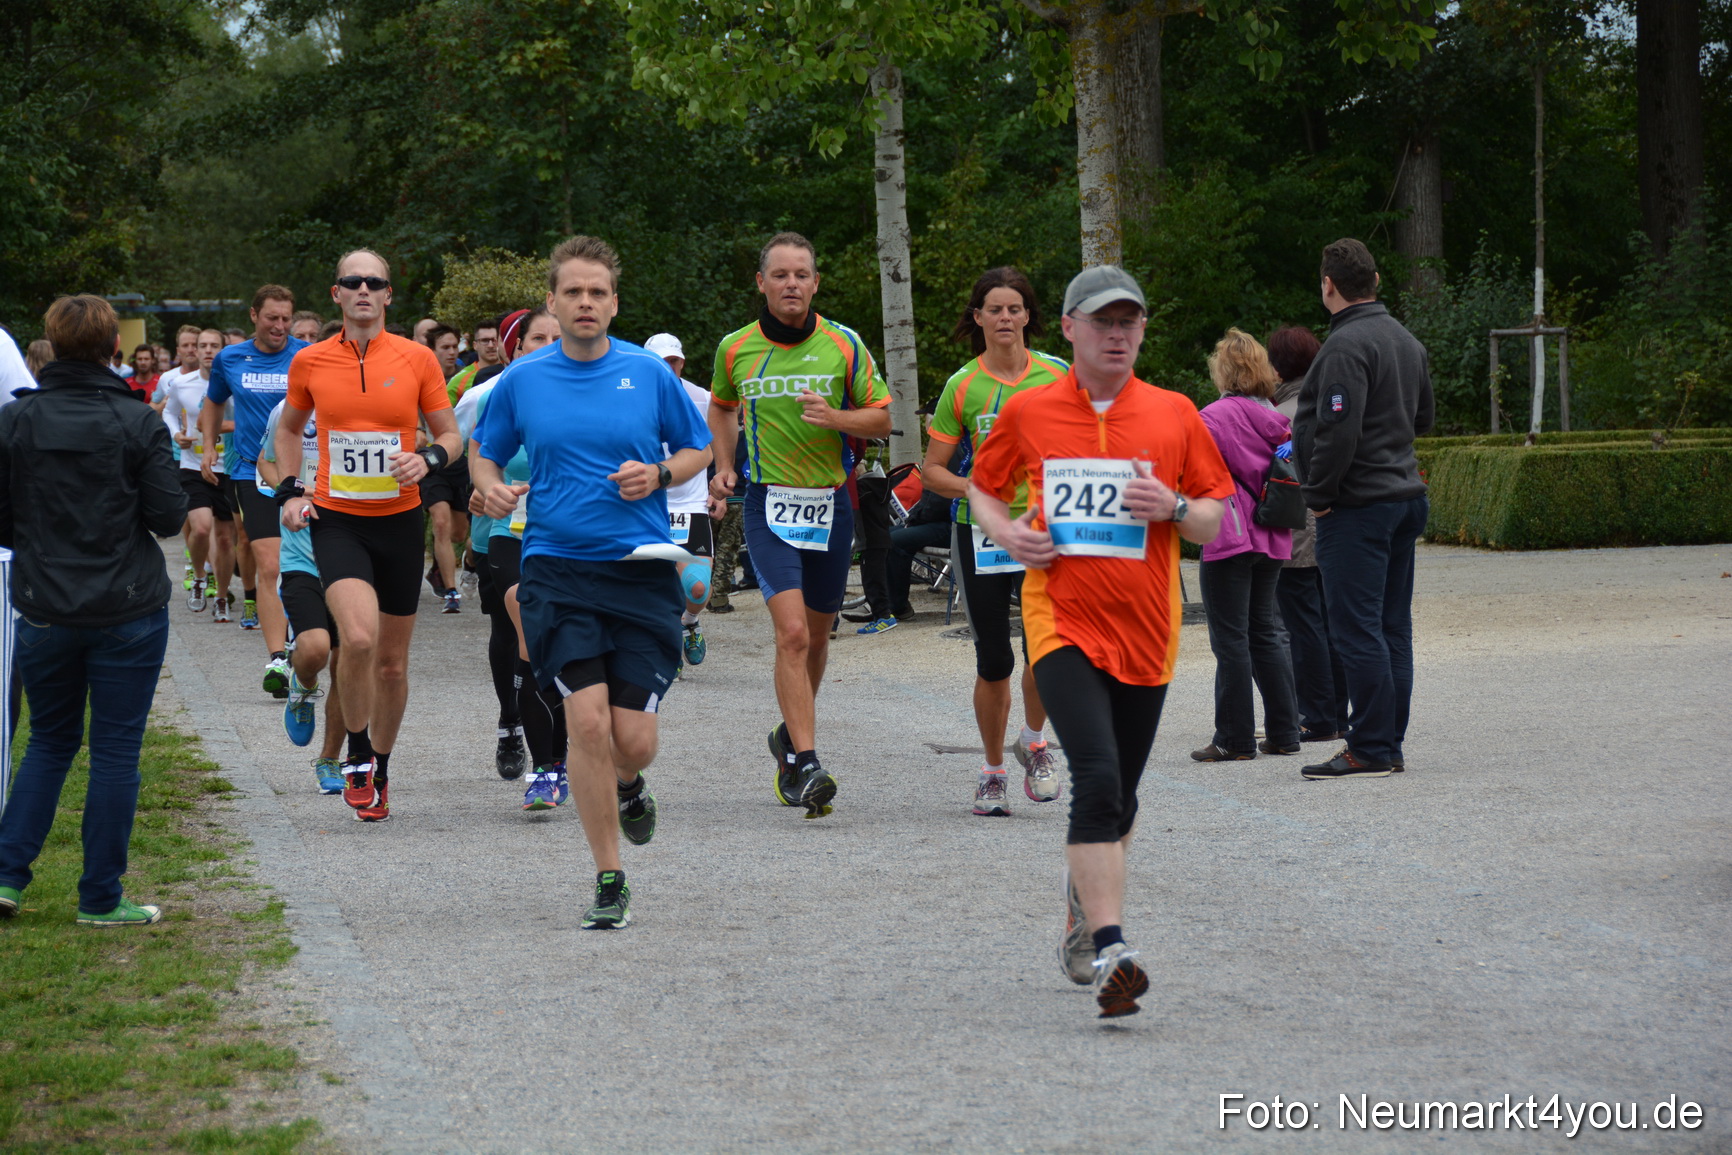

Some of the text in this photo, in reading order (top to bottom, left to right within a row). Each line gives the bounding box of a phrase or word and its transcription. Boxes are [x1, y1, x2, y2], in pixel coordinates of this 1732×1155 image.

[242, 372, 288, 383] HUBER
[742, 375, 834, 399] BOCK
[330, 437, 353, 446] PARTL
[343, 448, 385, 474] 511
[1046, 468, 1133, 480] PARTL Neumarkt
[769, 491, 826, 502] PARTL Neumarkt
[1053, 483, 1138, 520] 242
[773, 502, 828, 526] 2792
[788, 529, 815, 540] Gerald
[1074, 526, 1114, 542] Klaus
